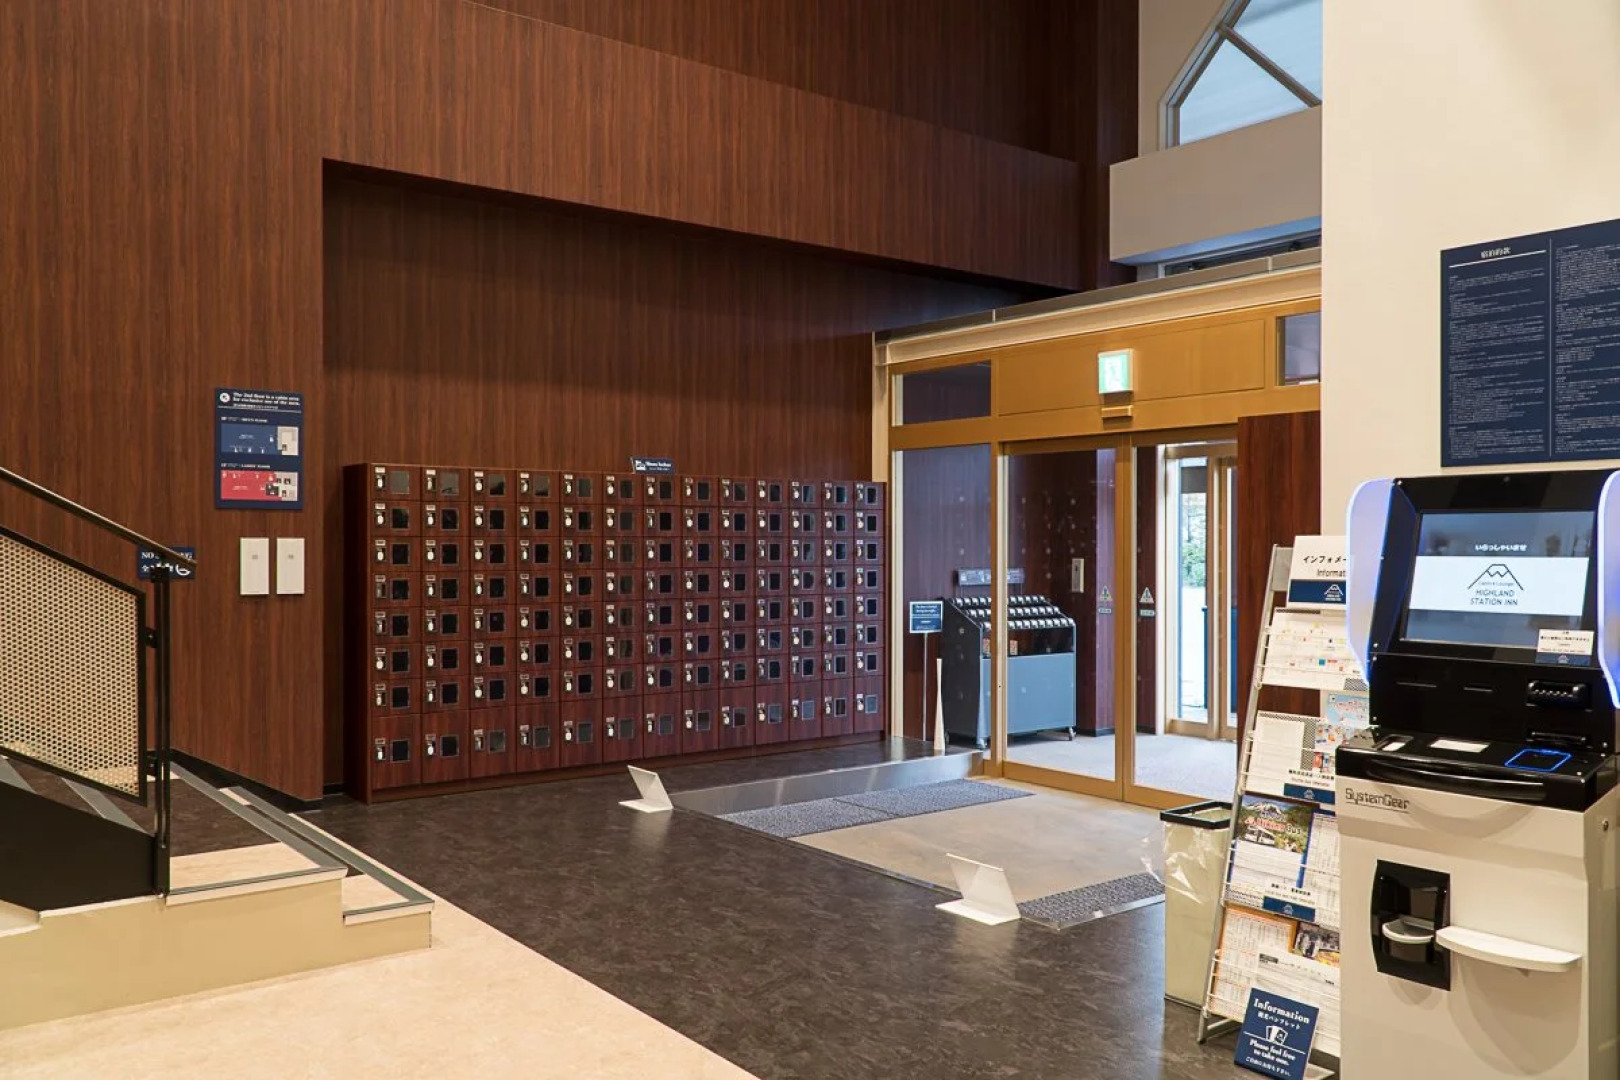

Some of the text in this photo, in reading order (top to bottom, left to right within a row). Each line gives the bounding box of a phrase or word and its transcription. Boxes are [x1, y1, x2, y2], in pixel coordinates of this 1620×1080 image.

[1475, 544, 1527, 552] いらっしゃいませ
[1476, 589, 1515, 597] HIGHLAND
[1470, 597, 1518, 606] STATION INN
[1345, 788, 1410, 809] SystemGear
[1253, 998, 1310, 1024] Information
[1249, 1039, 1296, 1061] Please feel free
